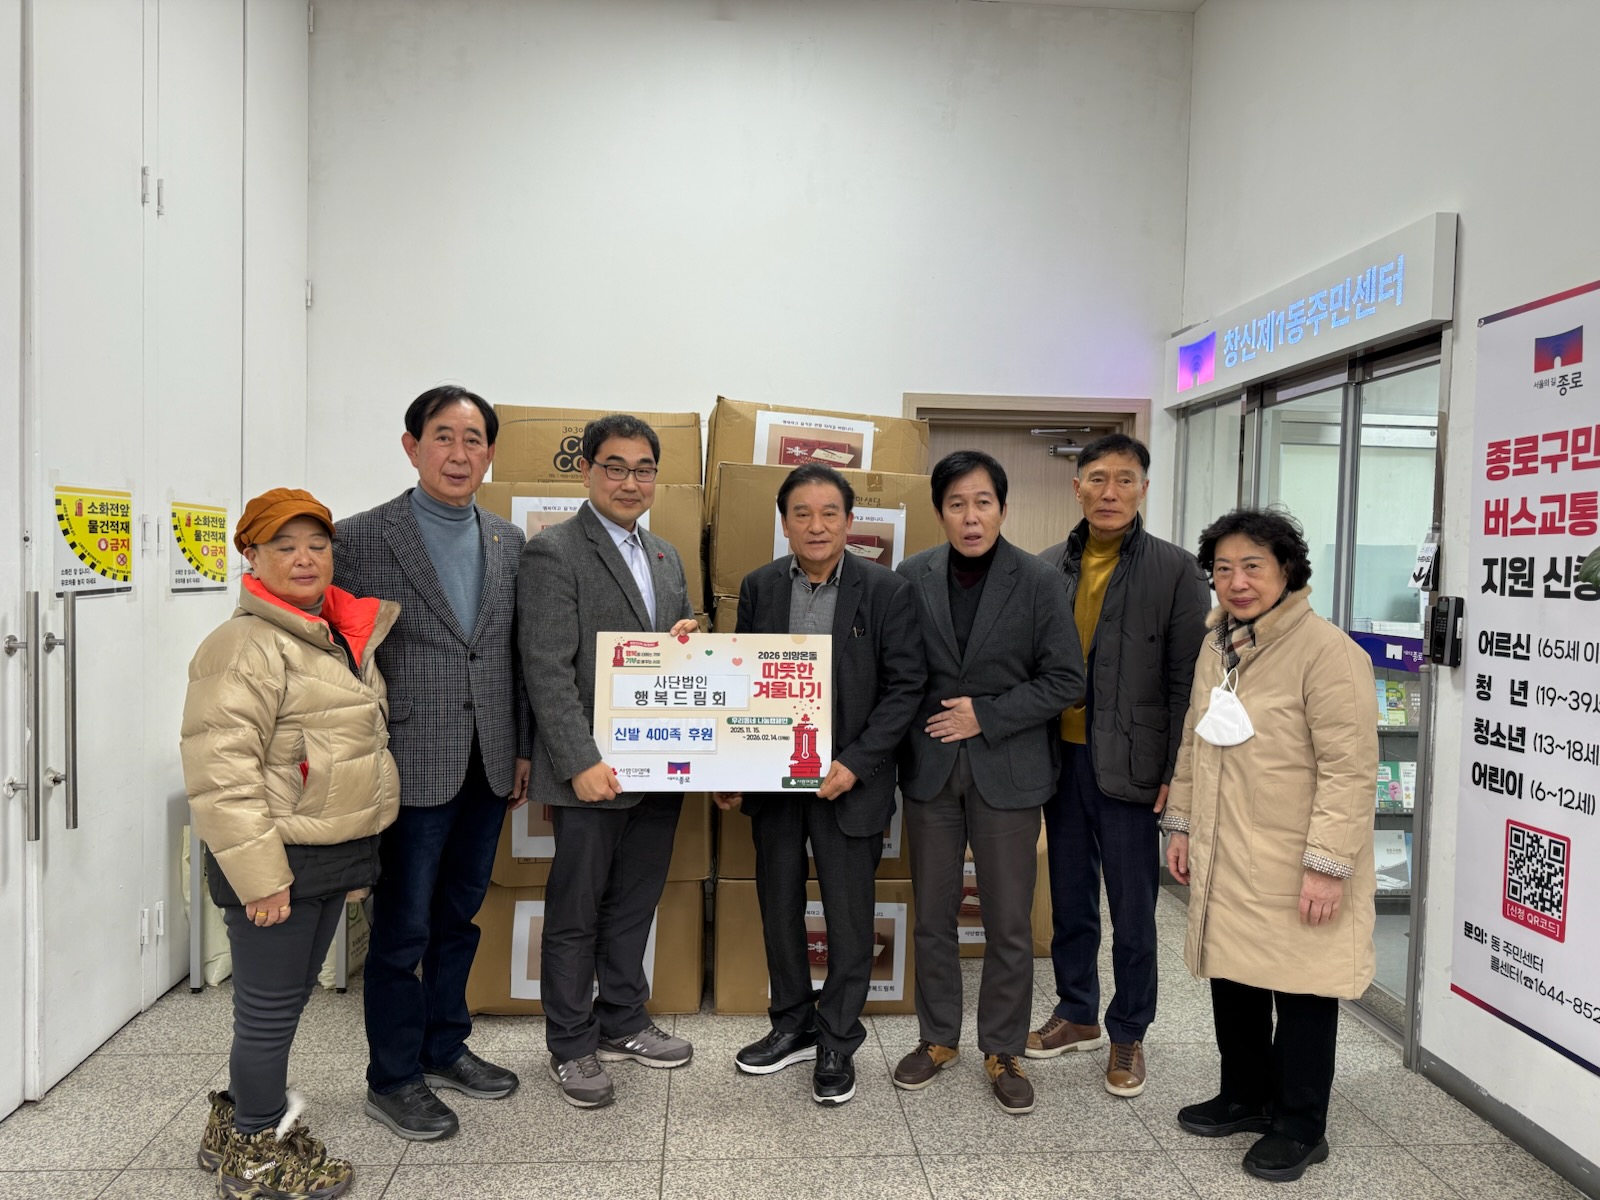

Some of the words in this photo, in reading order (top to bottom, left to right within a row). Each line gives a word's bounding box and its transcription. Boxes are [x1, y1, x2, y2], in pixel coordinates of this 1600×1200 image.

[1223, 254, 1404, 368] 창신제1동주민센터
[1556, 371, 1583, 396] 종로
[1486, 424, 1600, 481] 종로구민
[87, 501, 130, 518] 소화전앞
[1484, 491, 1599, 537] 버스교통
[87, 519, 130, 535] 물건적재
[194, 515, 226, 529] 소화전앞
[109, 538, 130, 552] 금지
[194, 530, 226, 543] 물건적재
[210, 545, 226, 557] 금지
[1481, 556, 1535, 598] 지원
[1478, 630, 1531, 661] 어르신
[1538, 637, 1580, 662] (65세
[757, 651, 780, 660] 2026
[782, 651, 818, 661] 희망온돌
[762, 662, 815, 680] 따뜻한
[654, 675, 707, 689] 사단법인
[753, 681, 822, 699] 겨울나기
[614, 727, 641, 742] 신발
[646, 727, 682, 741] 400족
[688, 727, 713, 742] 후원
[1474, 717, 1526, 754] 청소년
[1533, 732, 1600, 766] (13~18세
[1471, 761, 1523, 800] 어린이
[1530, 779, 1596, 816] (6~12세)
[1506, 903, 1525, 921] [신청
[1526, 913, 1560, 938] QR코드]
[1464, 920, 1487, 945] 문의:
[1491, 934, 1501, 953] 동
[1502, 940, 1544, 974] 주민센터
